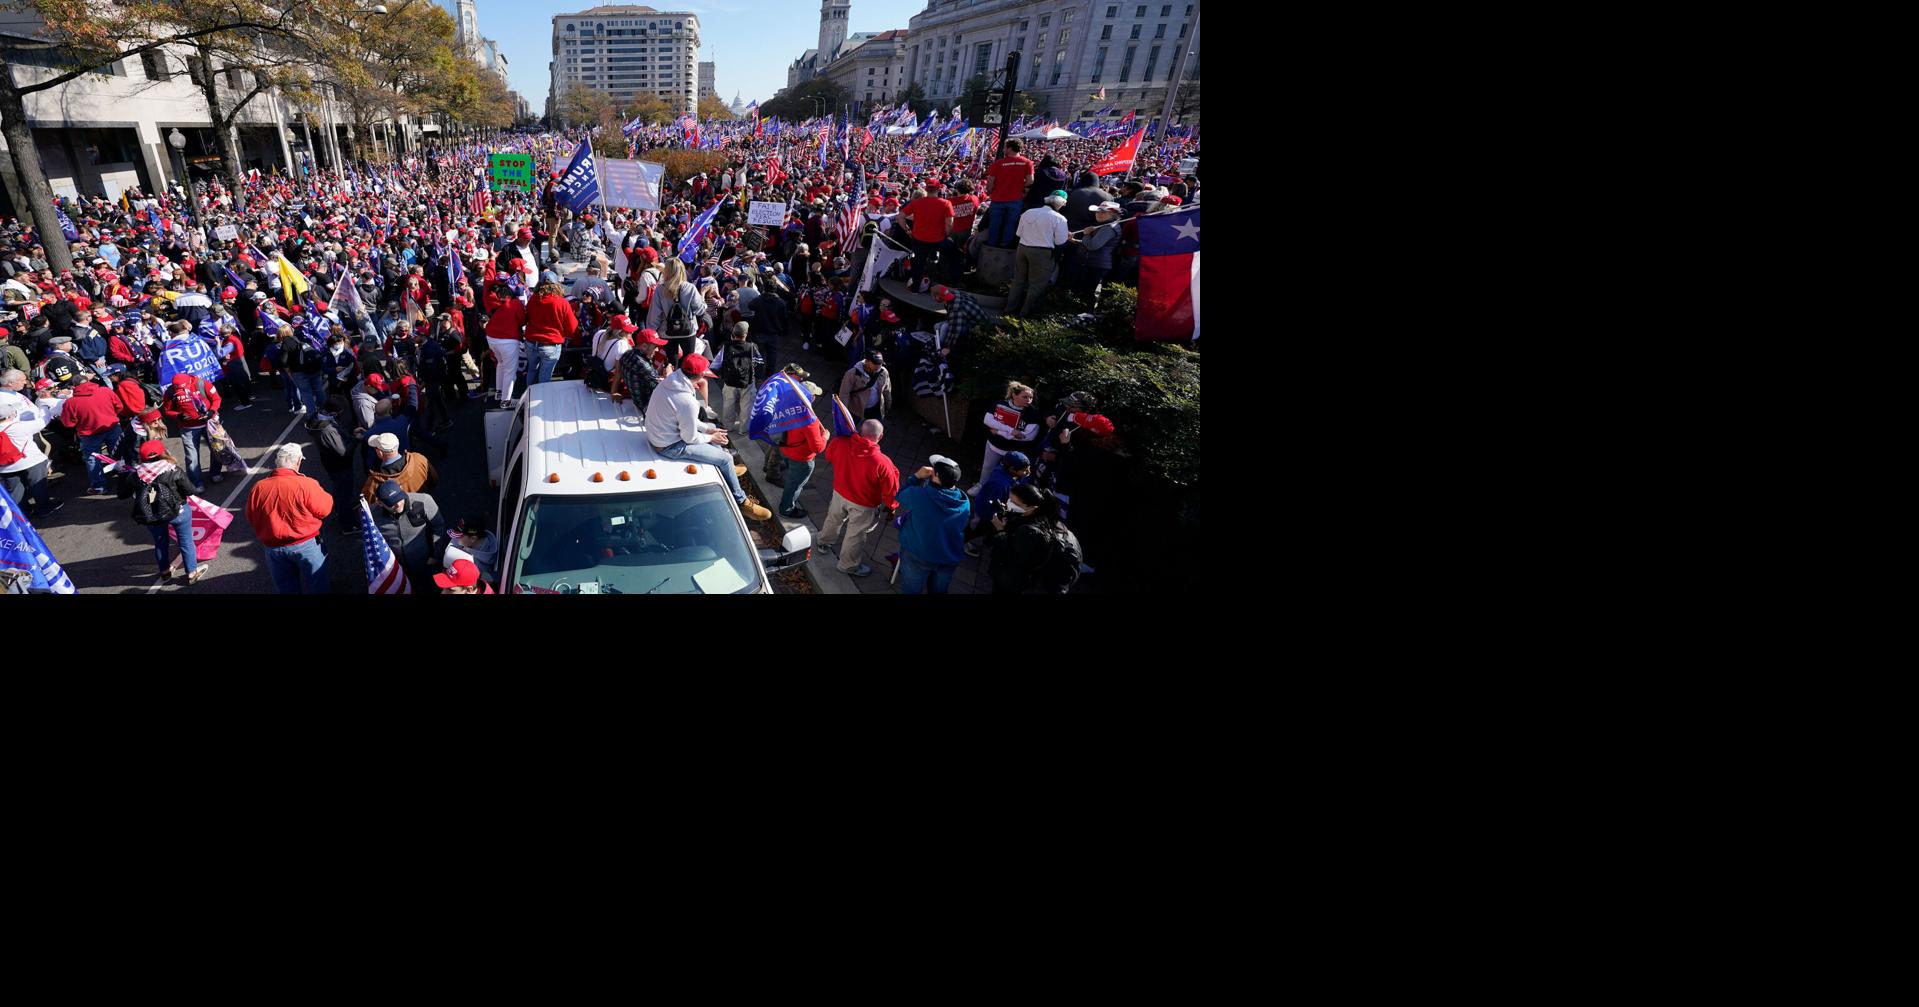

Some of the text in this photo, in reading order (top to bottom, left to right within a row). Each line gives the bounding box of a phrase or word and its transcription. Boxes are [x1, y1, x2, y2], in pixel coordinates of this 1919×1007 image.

[500, 159, 525, 168] STOP
[502, 169, 522, 178] THE
[497, 178, 527, 187] STEAL
[757, 202, 776, 210] FAIR
[55, 365, 70, 376] 95
